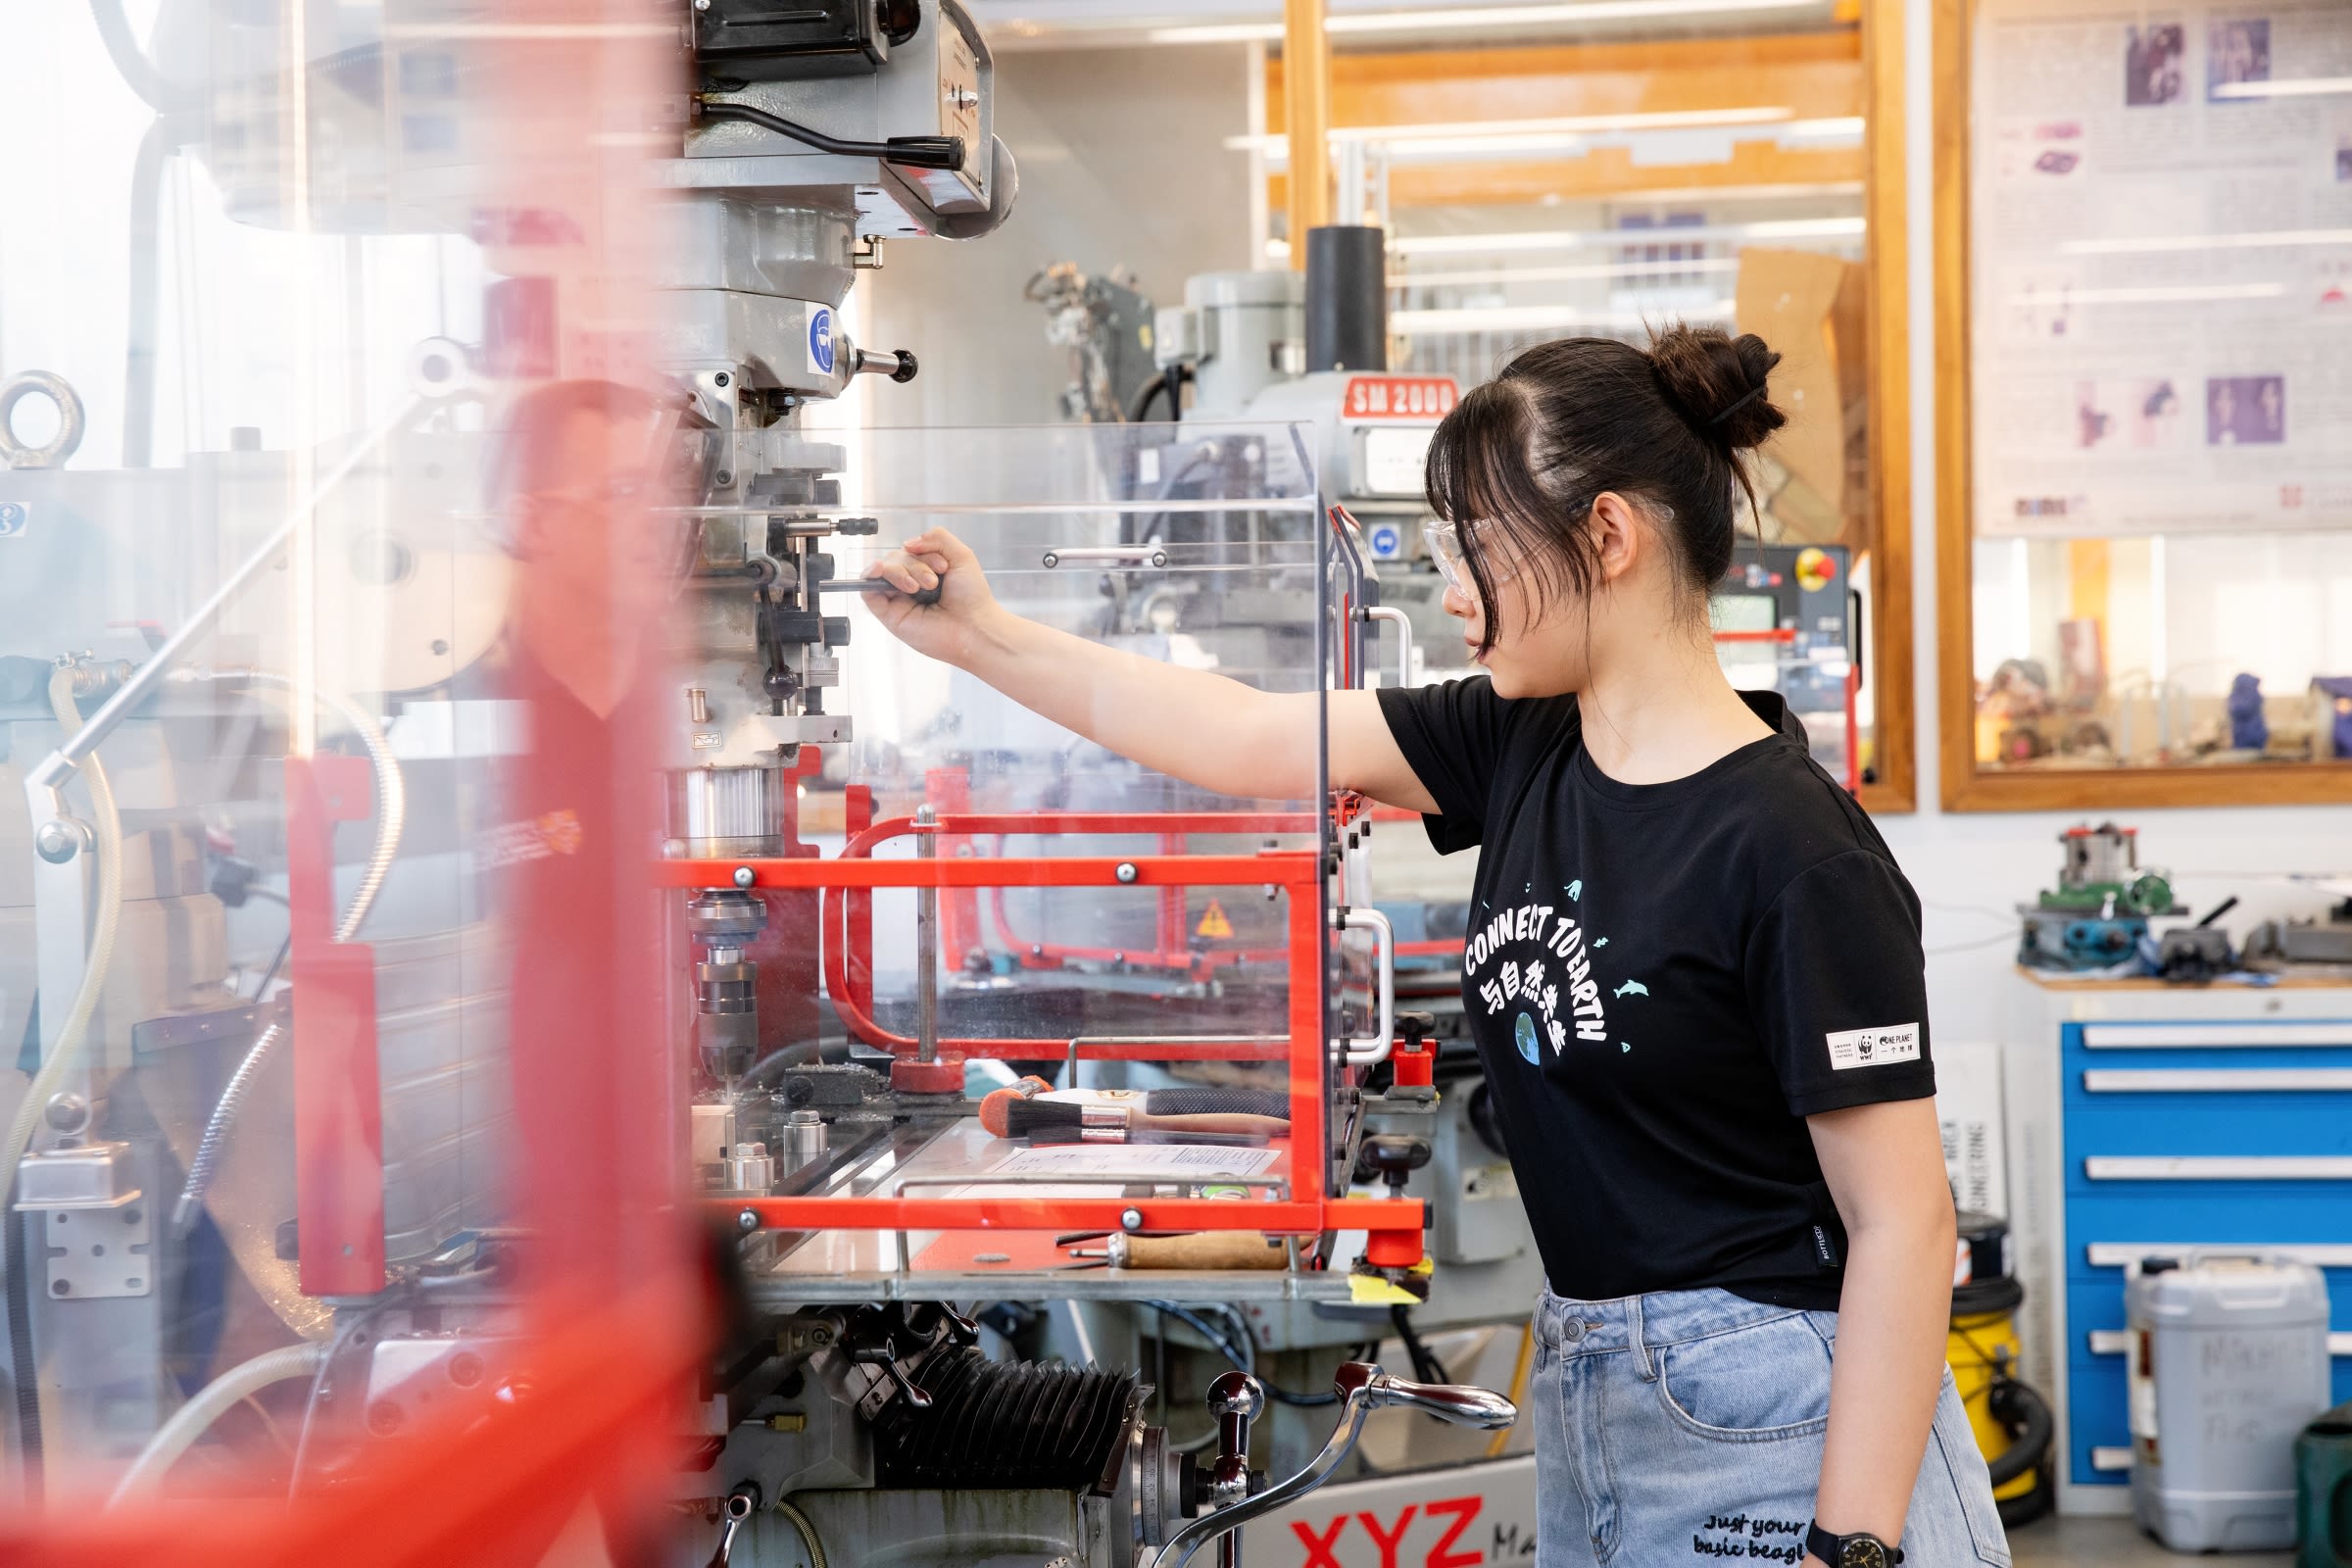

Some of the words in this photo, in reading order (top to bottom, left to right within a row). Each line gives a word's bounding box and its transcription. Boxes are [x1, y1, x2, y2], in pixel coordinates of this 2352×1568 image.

[1353, 383, 1388, 414] SM
[1394, 384, 1453, 414] 2000
[1465, 905, 1553, 976] CONNECT
[1547, 917, 1582, 957] TO
[1567, 944, 1607, 1041] EARTH
[1479, 959, 1566, 1057] 与自然共生
[1895, 1033, 1913, 1044] PLANET
[1290, 1494, 1484, 1568] XYZ
[1704, 1514, 1749, 1534] Just
[1751, 1520, 1806, 1538] your
[1693, 1535, 1745, 1557] basic
[1749, 1540, 1805, 1565] beagl
